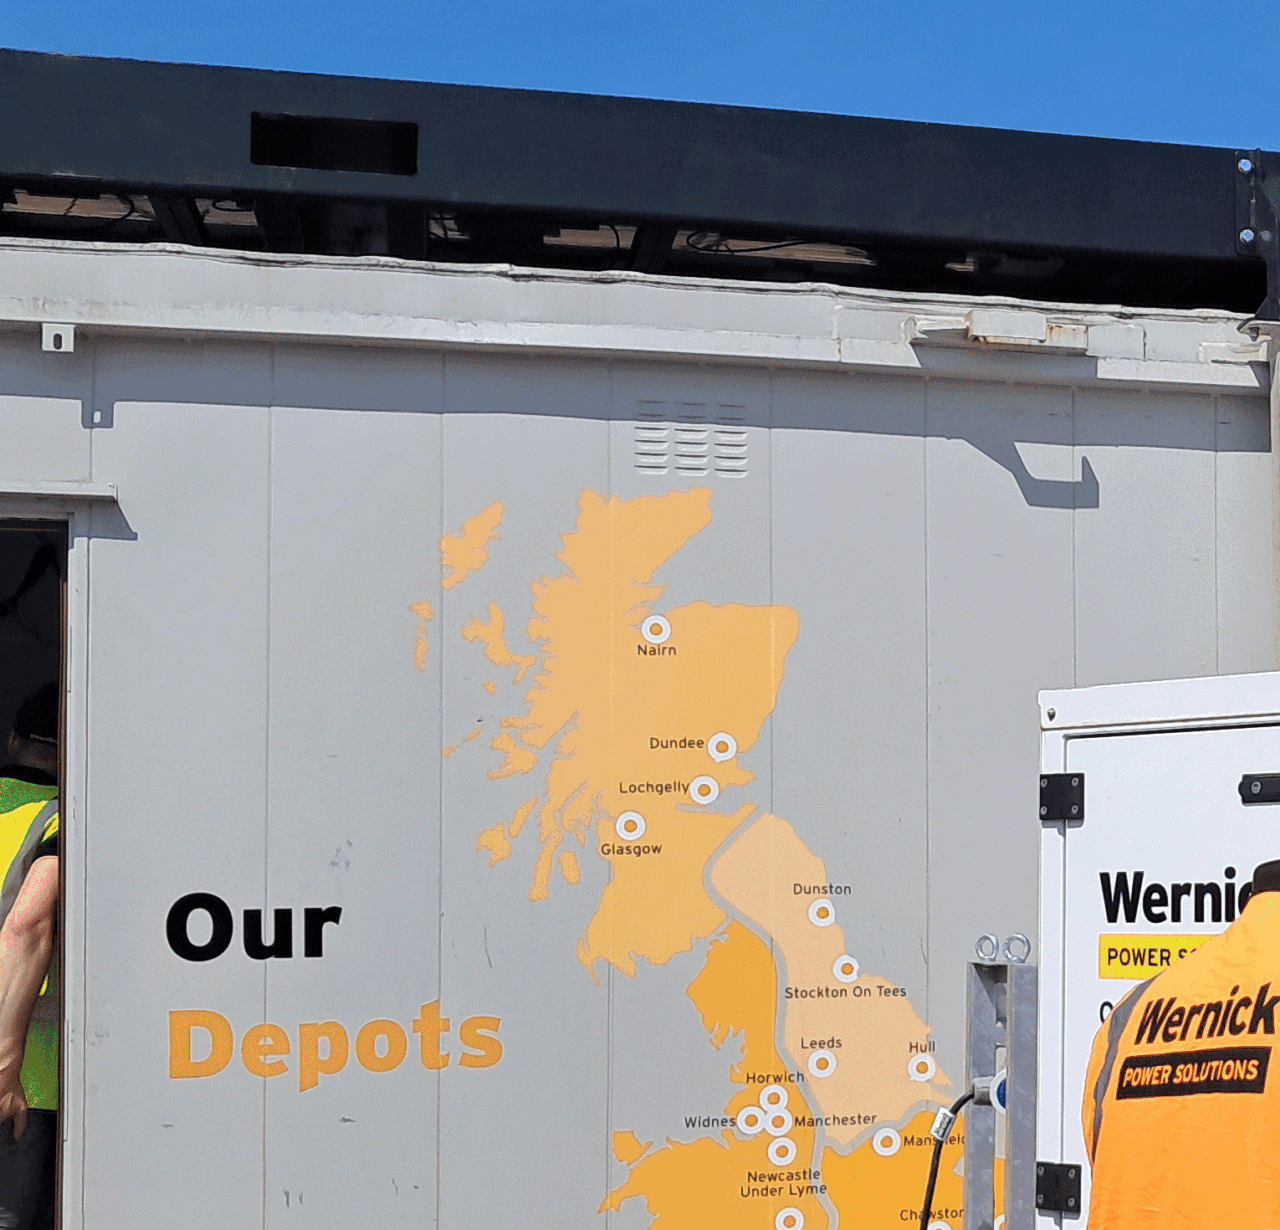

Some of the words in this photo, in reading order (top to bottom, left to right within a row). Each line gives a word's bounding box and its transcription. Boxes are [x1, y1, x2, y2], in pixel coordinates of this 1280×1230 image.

[637, 644, 677, 656] Nairn
[649, 737, 705, 750] Dundee
[619, 779, 690, 796] Lochgelly
[600, 842, 662, 857] Glasgow
[793, 882, 852, 896] Dunston
[166, 892, 343, 962] Our
[1107, 947, 1171, 966] POWER
[784, 985, 848, 999] Stockton
[852, 986, 872, 998] On
[876, 985, 907, 998] Tees
[168, 999, 503, 1093] Depots
[801, 1036, 842, 1049] Leeds
[909, 1040, 936, 1053] Hull
[746, 1070, 805, 1084] Horwich
[1123, 1064, 1172, 1087] POWER
[1173, 1059, 1260, 1085] SOLUTIONS
[684, 1115, 736, 1129] Widnes
[794, 1113, 877, 1128] Manchester
[747, 1168, 821, 1183] Newcastle
[740, 1185, 783, 1198] Under
[789, 1184, 828, 1198] Lyme
